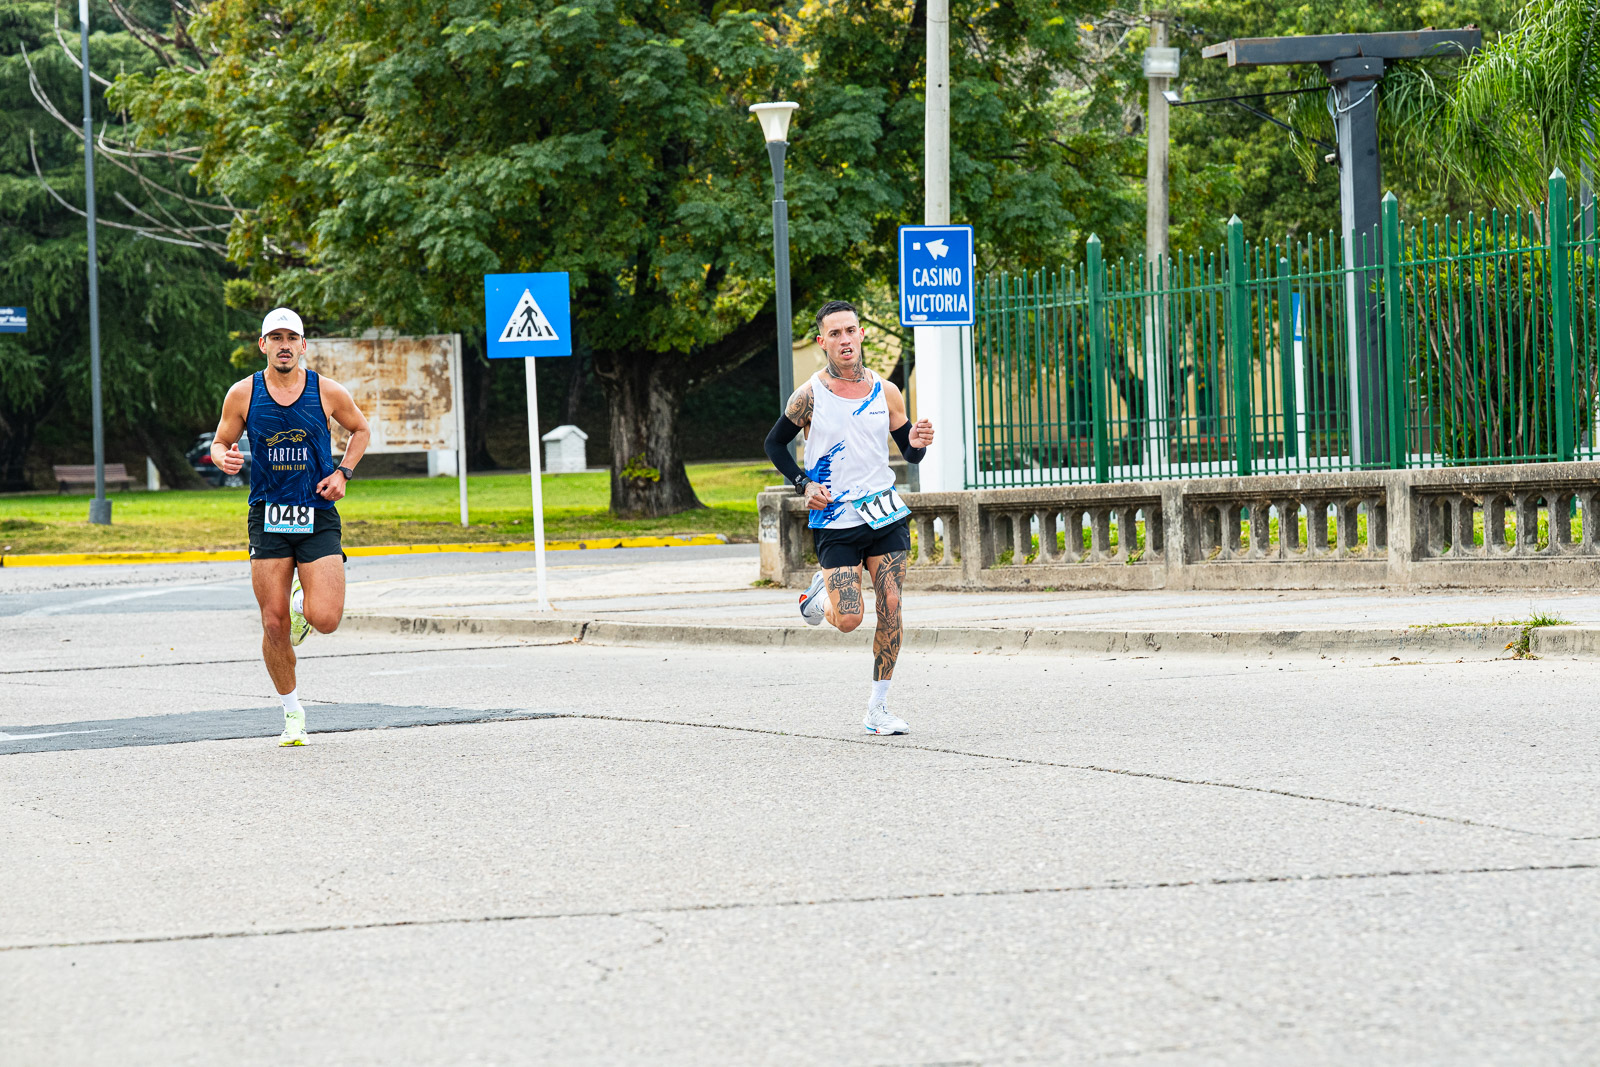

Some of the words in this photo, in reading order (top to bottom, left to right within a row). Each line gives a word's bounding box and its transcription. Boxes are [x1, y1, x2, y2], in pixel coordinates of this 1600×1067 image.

[912, 267, 962, 287] CASINO
[906, 293, 968, 312] VICTORIA
[268, 447, 308, 461] FARTLEK
[293, 463, 306, 471] CLUB
[818, 454, 835, 521] ARTINA
[267, 502, 310, 526] 048
[859, 489, 898, 521] 117
